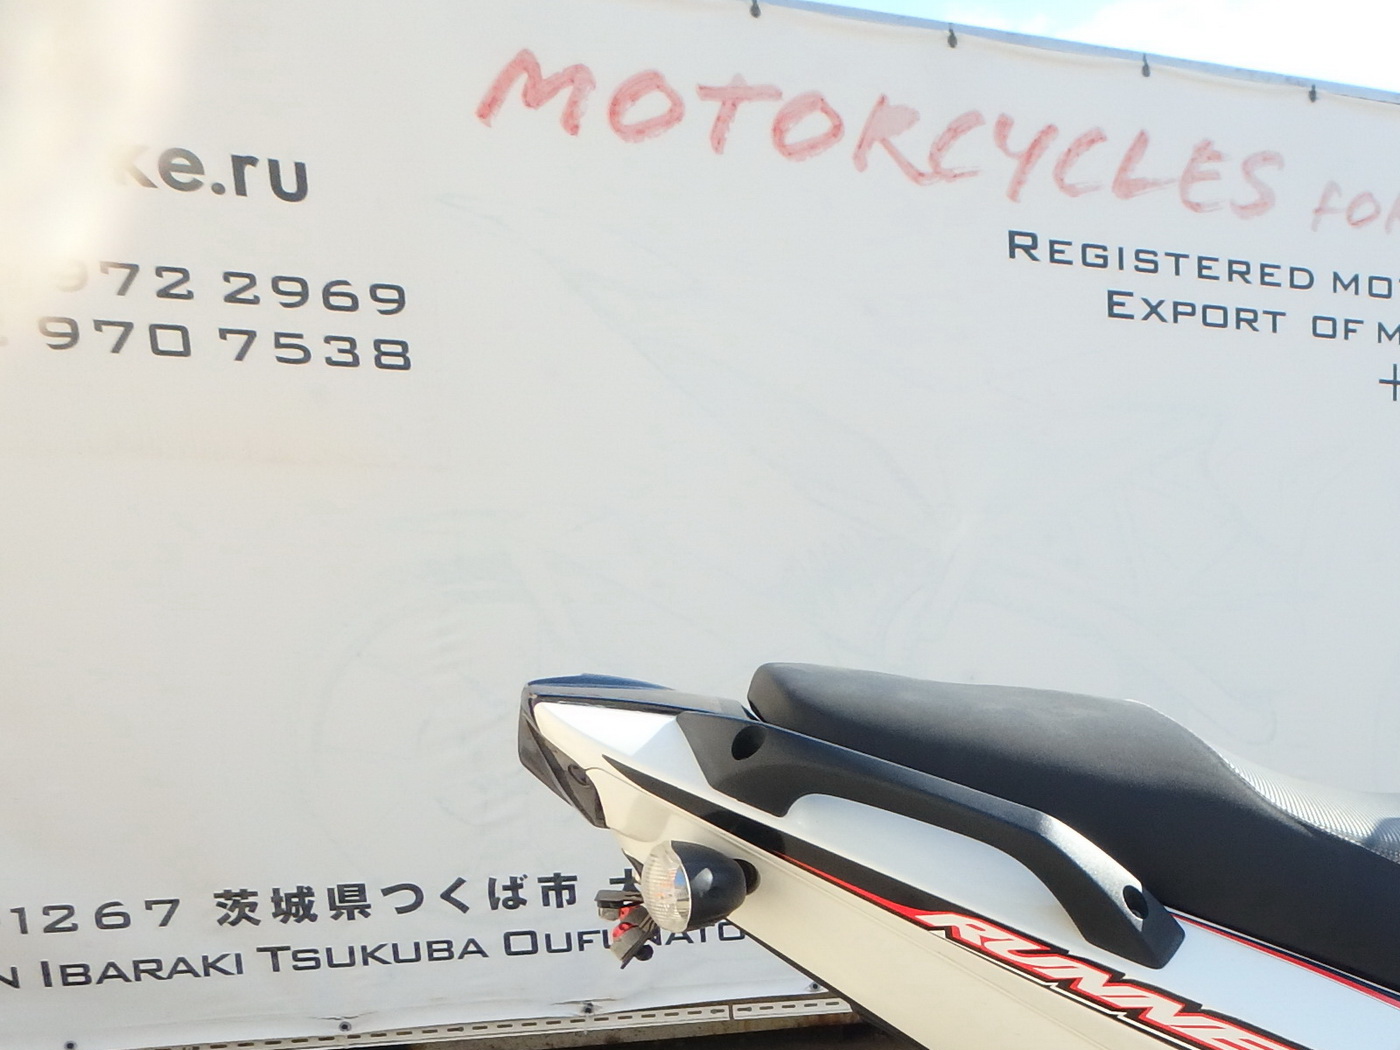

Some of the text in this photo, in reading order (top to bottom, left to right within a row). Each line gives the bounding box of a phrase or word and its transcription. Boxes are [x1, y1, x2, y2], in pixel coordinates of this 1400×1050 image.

[475, 48, 1284, 219] MOTORCYCLES
[1007, 229, 1314, 291] REGISTERED
[222, 270, 407, 316] 2969
[1106, 289, 1286, 334] EXPORT
[1311, 315, 1364, 341] OF
[37, 315, 412, 371] 970 7538
[213, 872, 578, 928] 茨城県つくば市
[40, 952, 243, 987] IBARAKI
[257, 937, 487, 972] TSUKUBA
